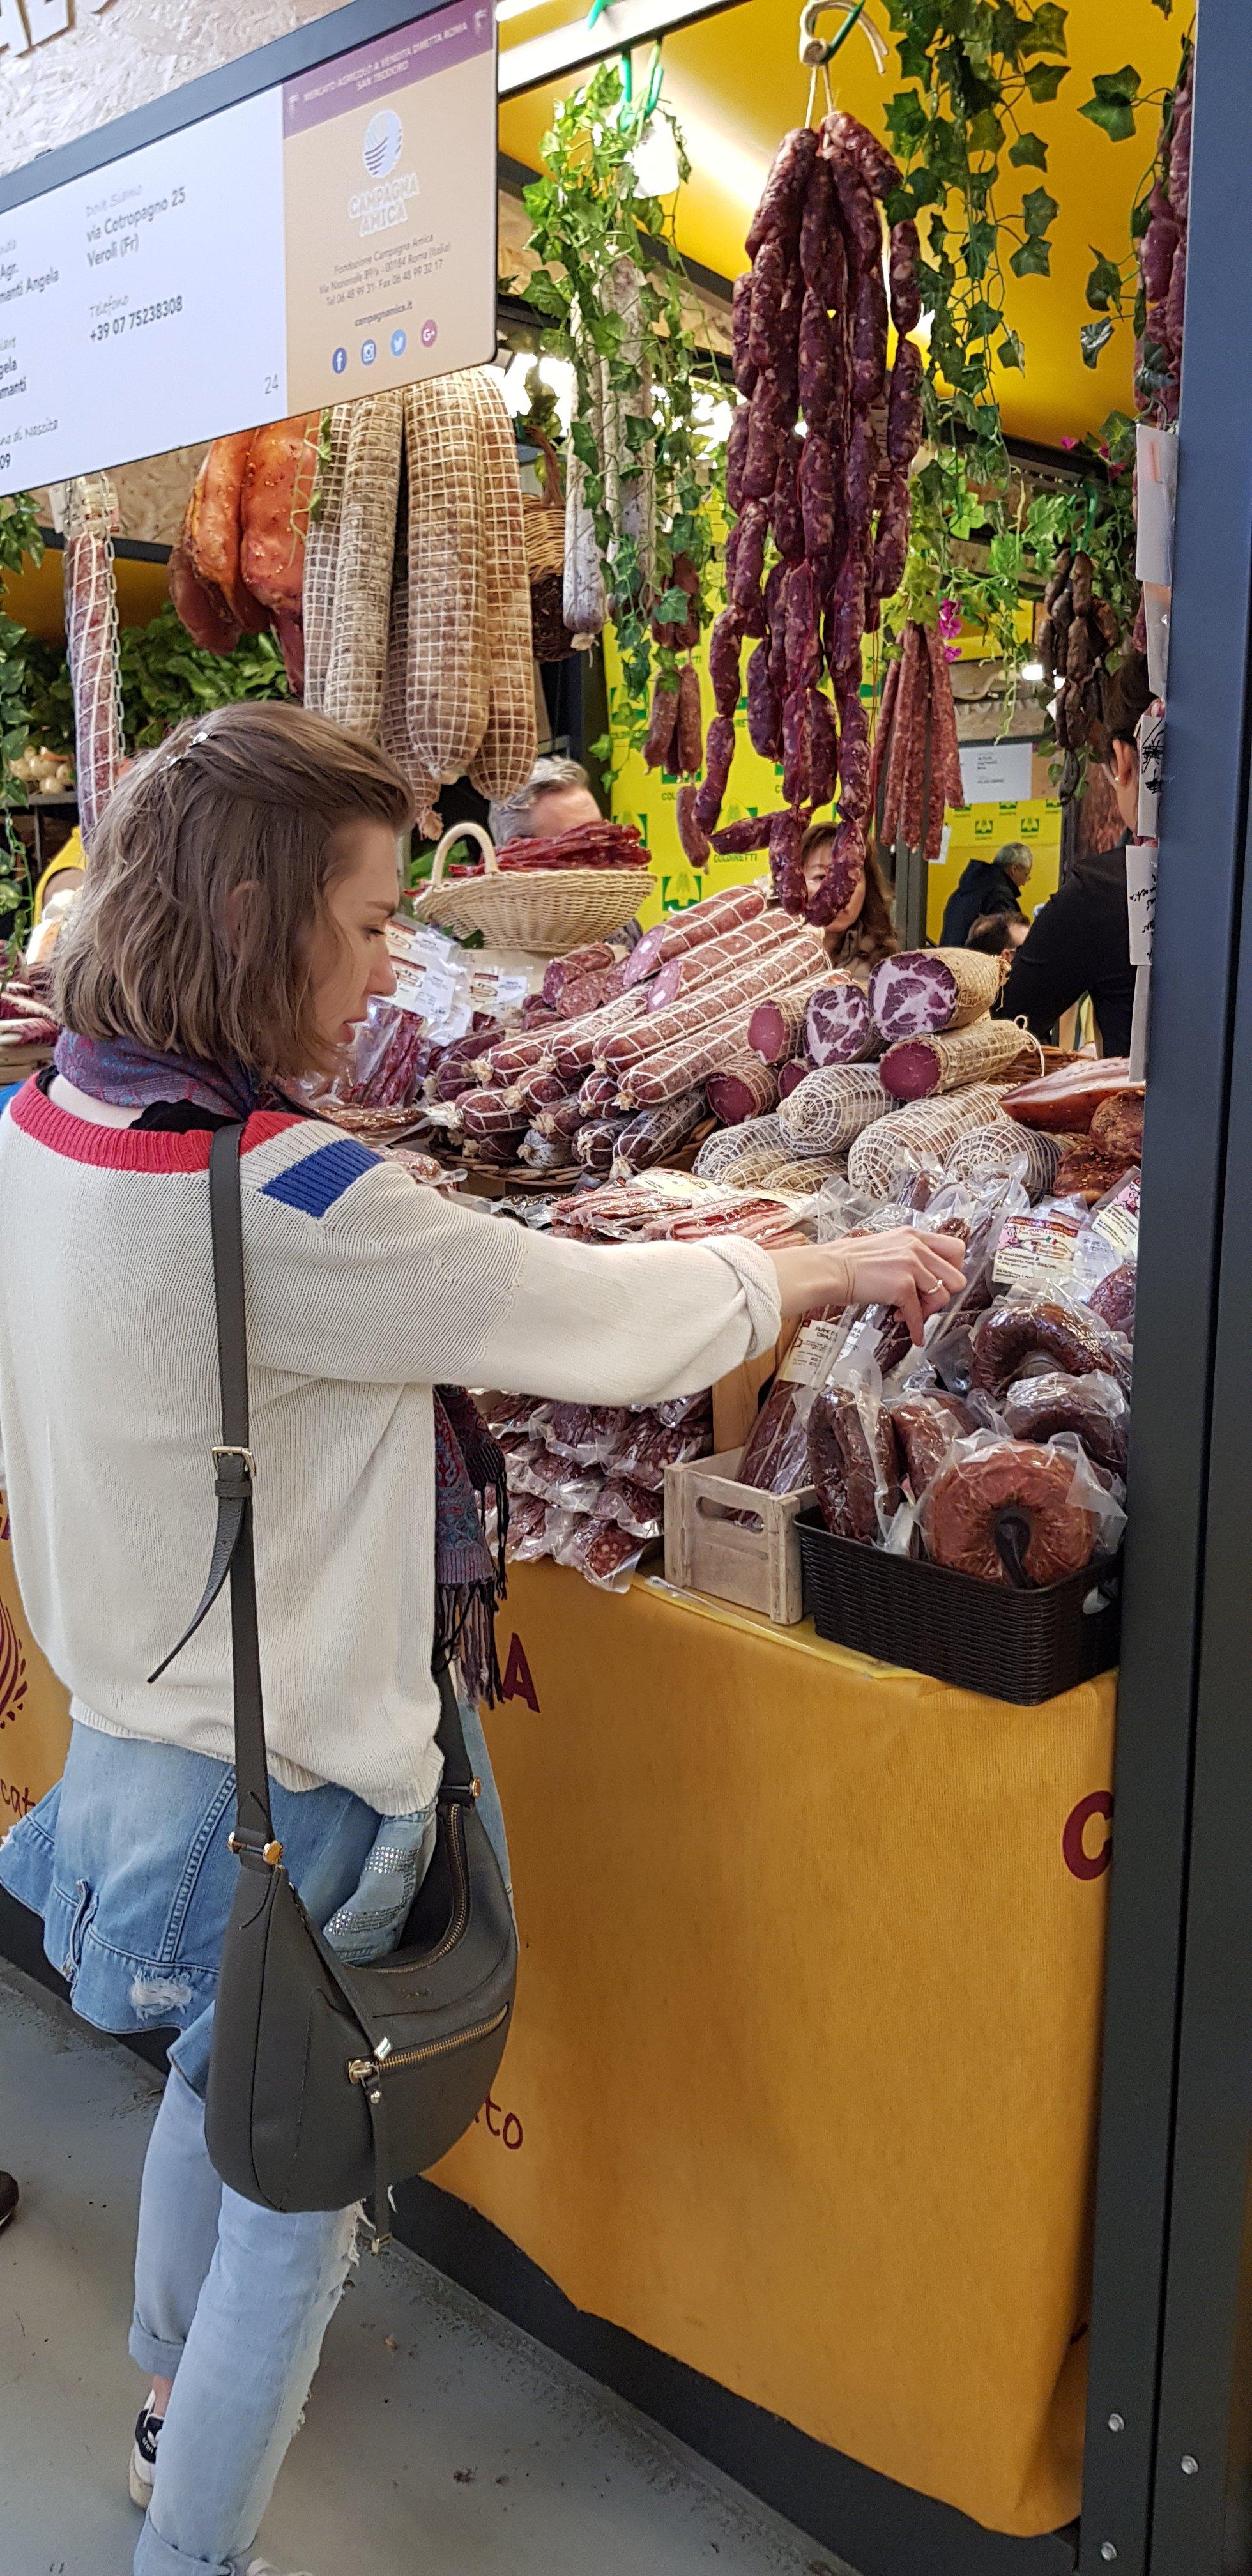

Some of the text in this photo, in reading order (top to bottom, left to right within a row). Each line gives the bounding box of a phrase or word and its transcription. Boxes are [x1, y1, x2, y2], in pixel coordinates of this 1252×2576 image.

[348, 172, 420, 219] CAMPAGNA
[86, 225, 101, 243] via
[172, 186, 185, 207] 25
[360, 199, 408, 237] AMICA
[86, 233, 139, 267] Veroli (Fr)
[335, 257, 372, 274] Fondazione
[373, 243, 410, 263] Campagna
[26, 267, 59, 293] Angela
[89, 295, 183, 342] +39 07 75238308
[264, 374, 279, 394] 24
